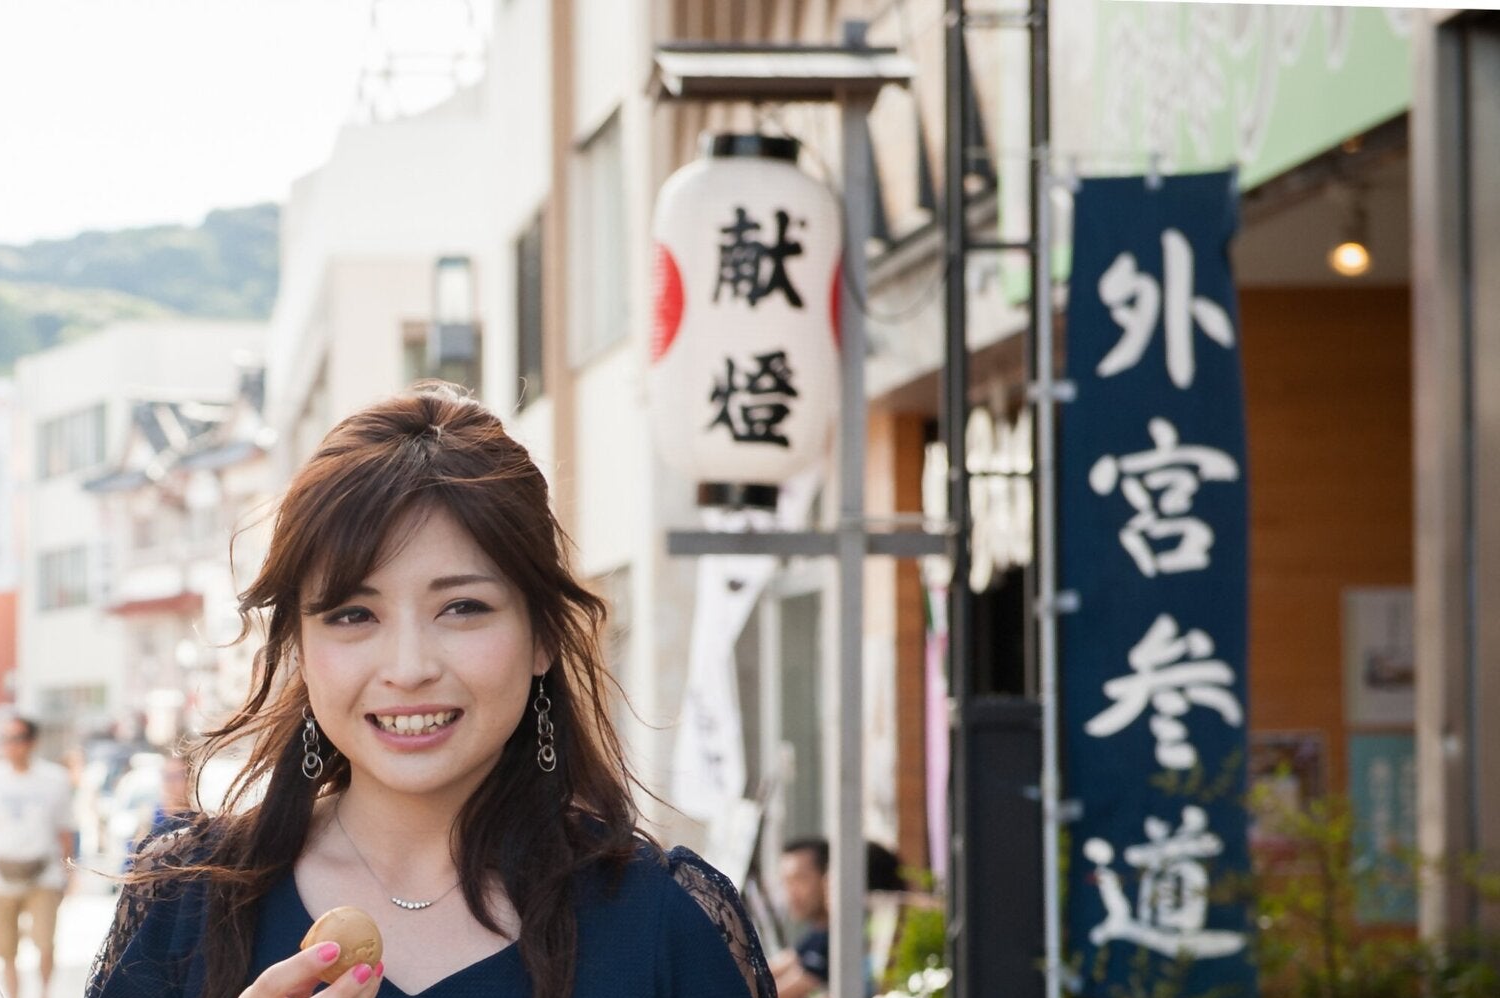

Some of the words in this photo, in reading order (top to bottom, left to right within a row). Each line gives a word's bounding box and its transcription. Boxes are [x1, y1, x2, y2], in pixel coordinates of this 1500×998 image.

[707, 207, 806, 449] 献燈
[1084, 228, 1248, 960] 外宮参道
